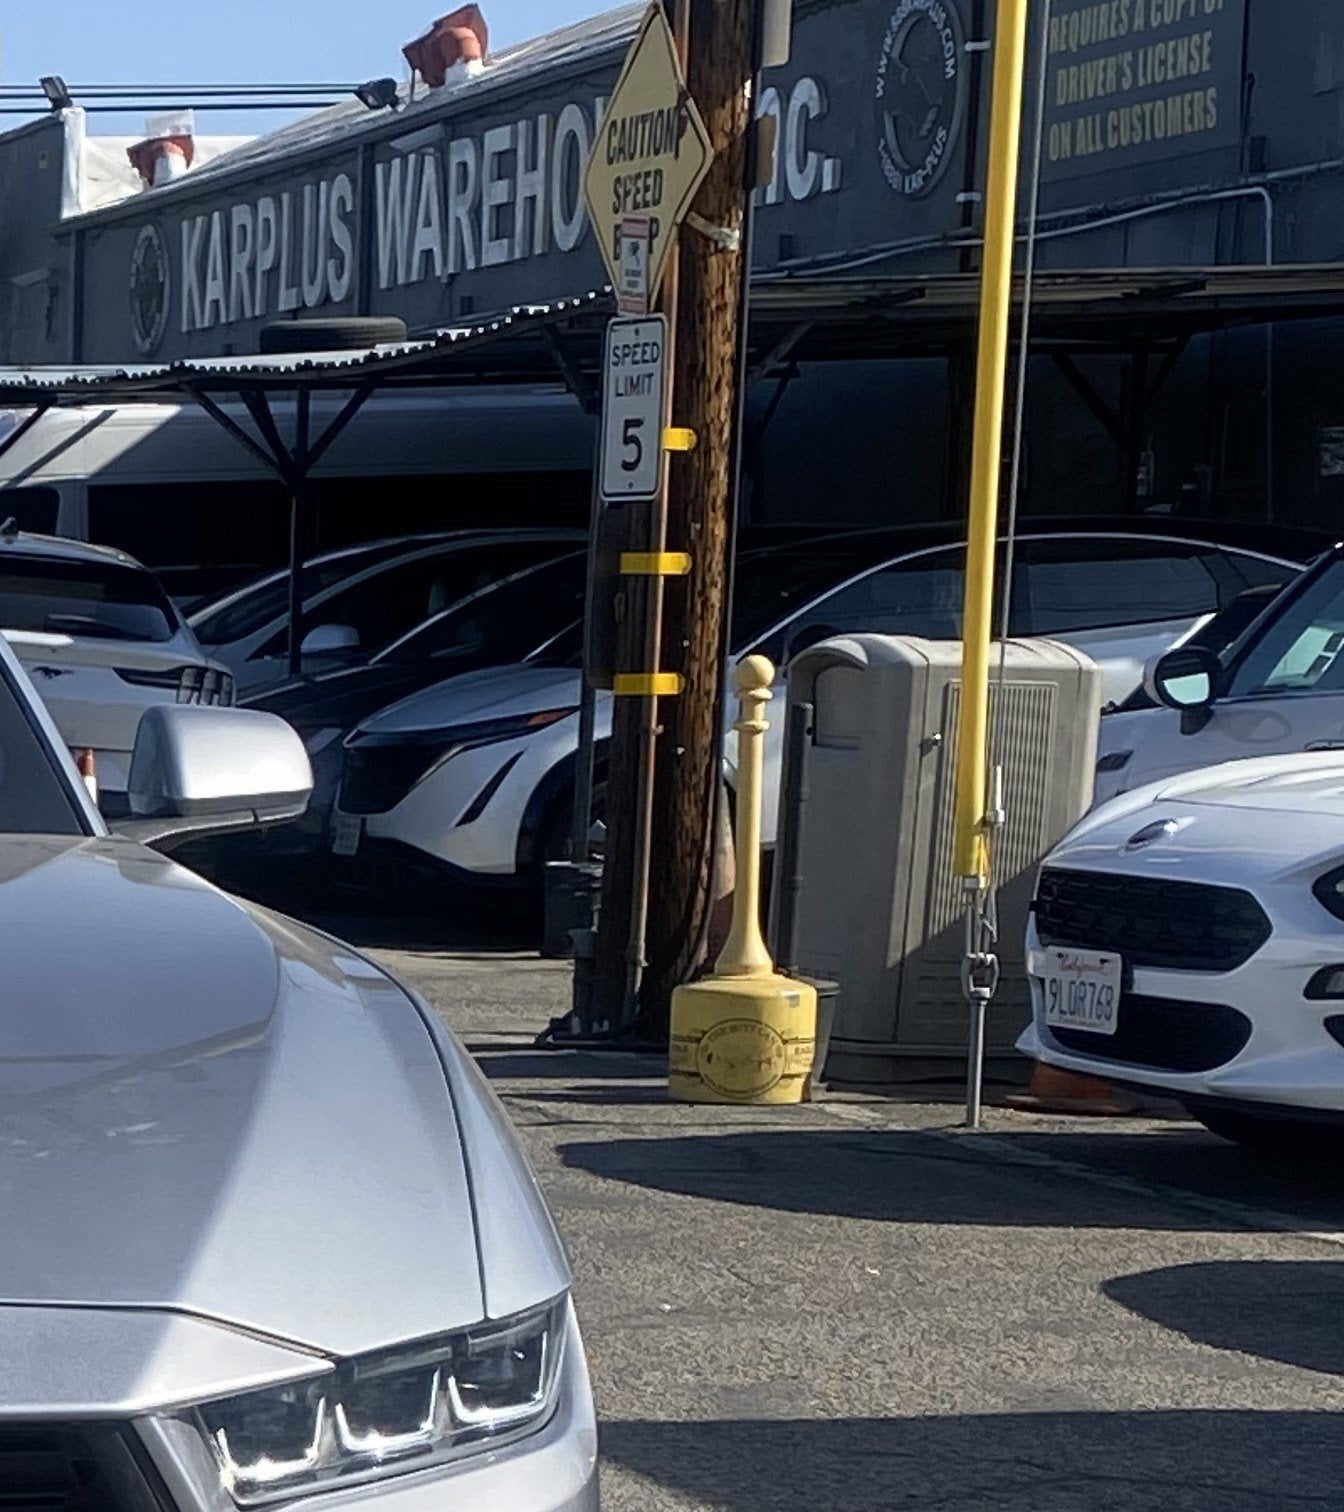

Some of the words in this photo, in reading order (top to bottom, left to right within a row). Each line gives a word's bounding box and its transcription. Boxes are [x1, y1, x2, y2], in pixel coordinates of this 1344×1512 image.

[1049, 0, 1129, 53] REQUIRES
[1133, 0, 1145, 33] A
[1056, 51, 1133, 105] DRIVER'S
[1138, 30, 1212, 87] LICENSE
[606, 103, 680, 165] CAUTION
[1049, 120, 1072, 161] ON
[1076, 113, 1105, 155] ALL
[1107, 87, 1217, 149] CUSTOMERS
[613, 167, 664, 215] SPEED
[180, 173, 355, 333] KARPLUS
[611, 341, 660, 367] SPEED
[614, 372, 655, 398] LIMIT
[620, 417, 645, 472] 5
